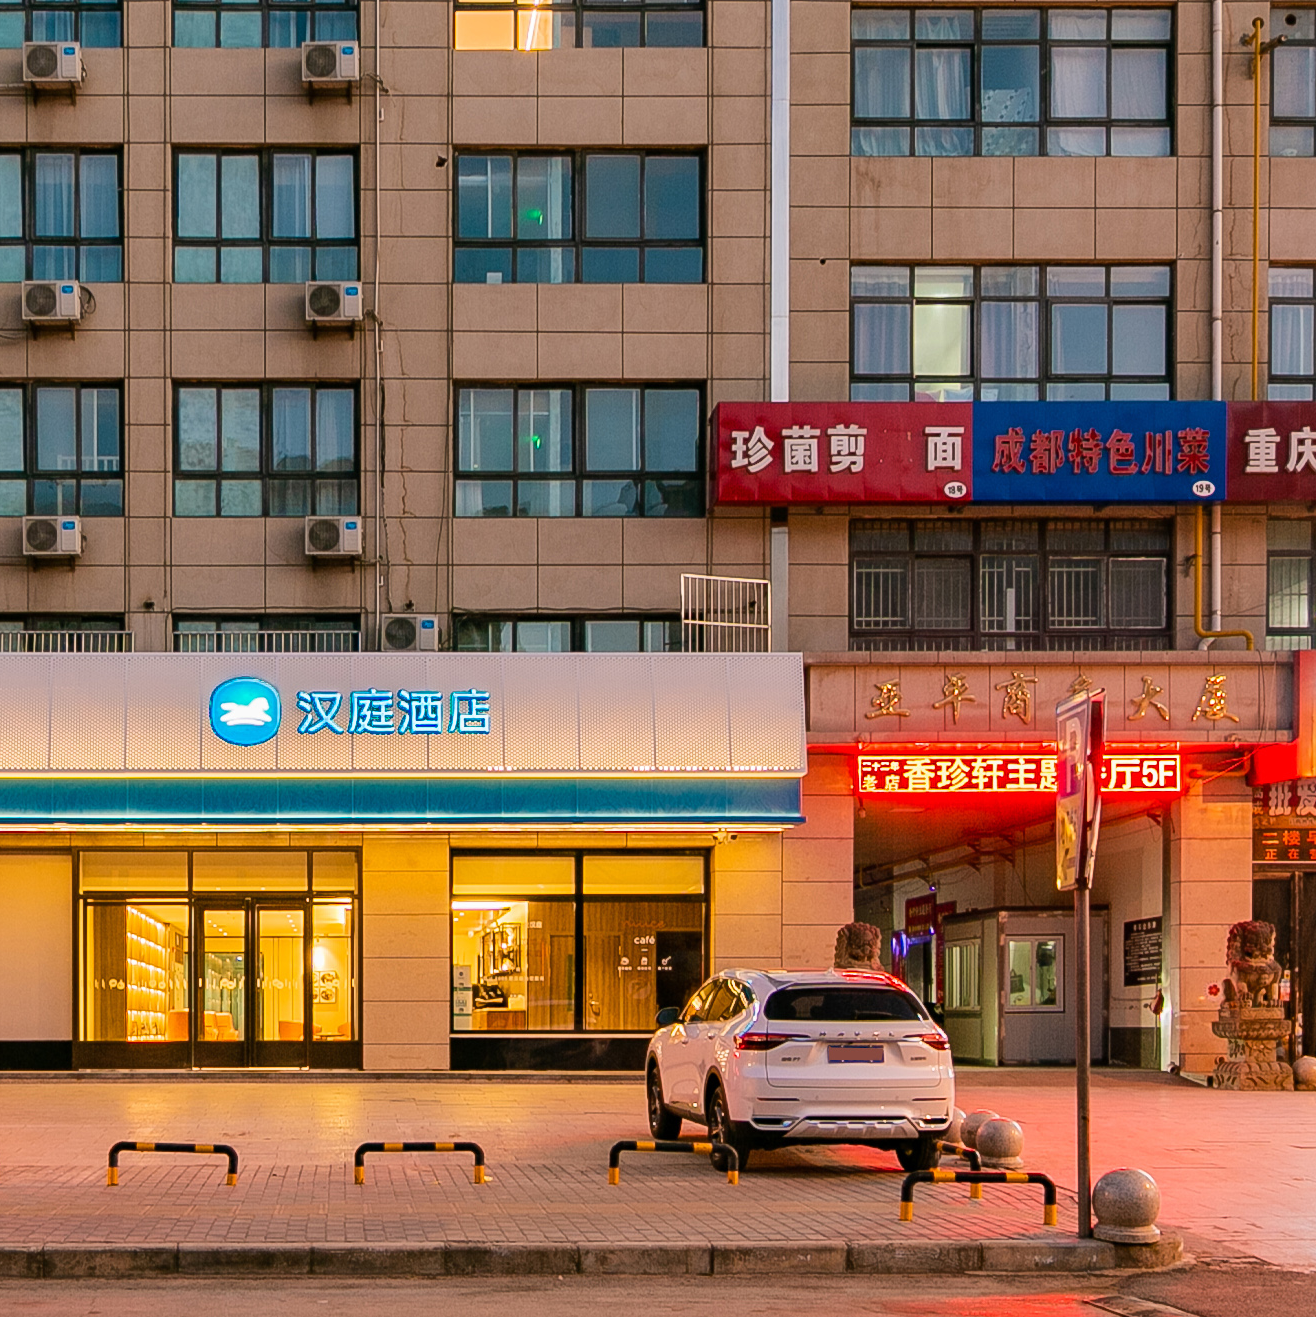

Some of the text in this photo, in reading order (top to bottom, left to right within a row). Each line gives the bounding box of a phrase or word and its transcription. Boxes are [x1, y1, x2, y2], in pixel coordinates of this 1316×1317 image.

[730, 423, 965, 474] 珍菌剪 面
[990, 427, 1213, 475] 成都特色川菜
[295, 687, 492, 735] 汉庭酒店
[1065, 716, 1082, 794] P
[862, 775, 901, 792] 老店
[633, 935, 656, 945] café
